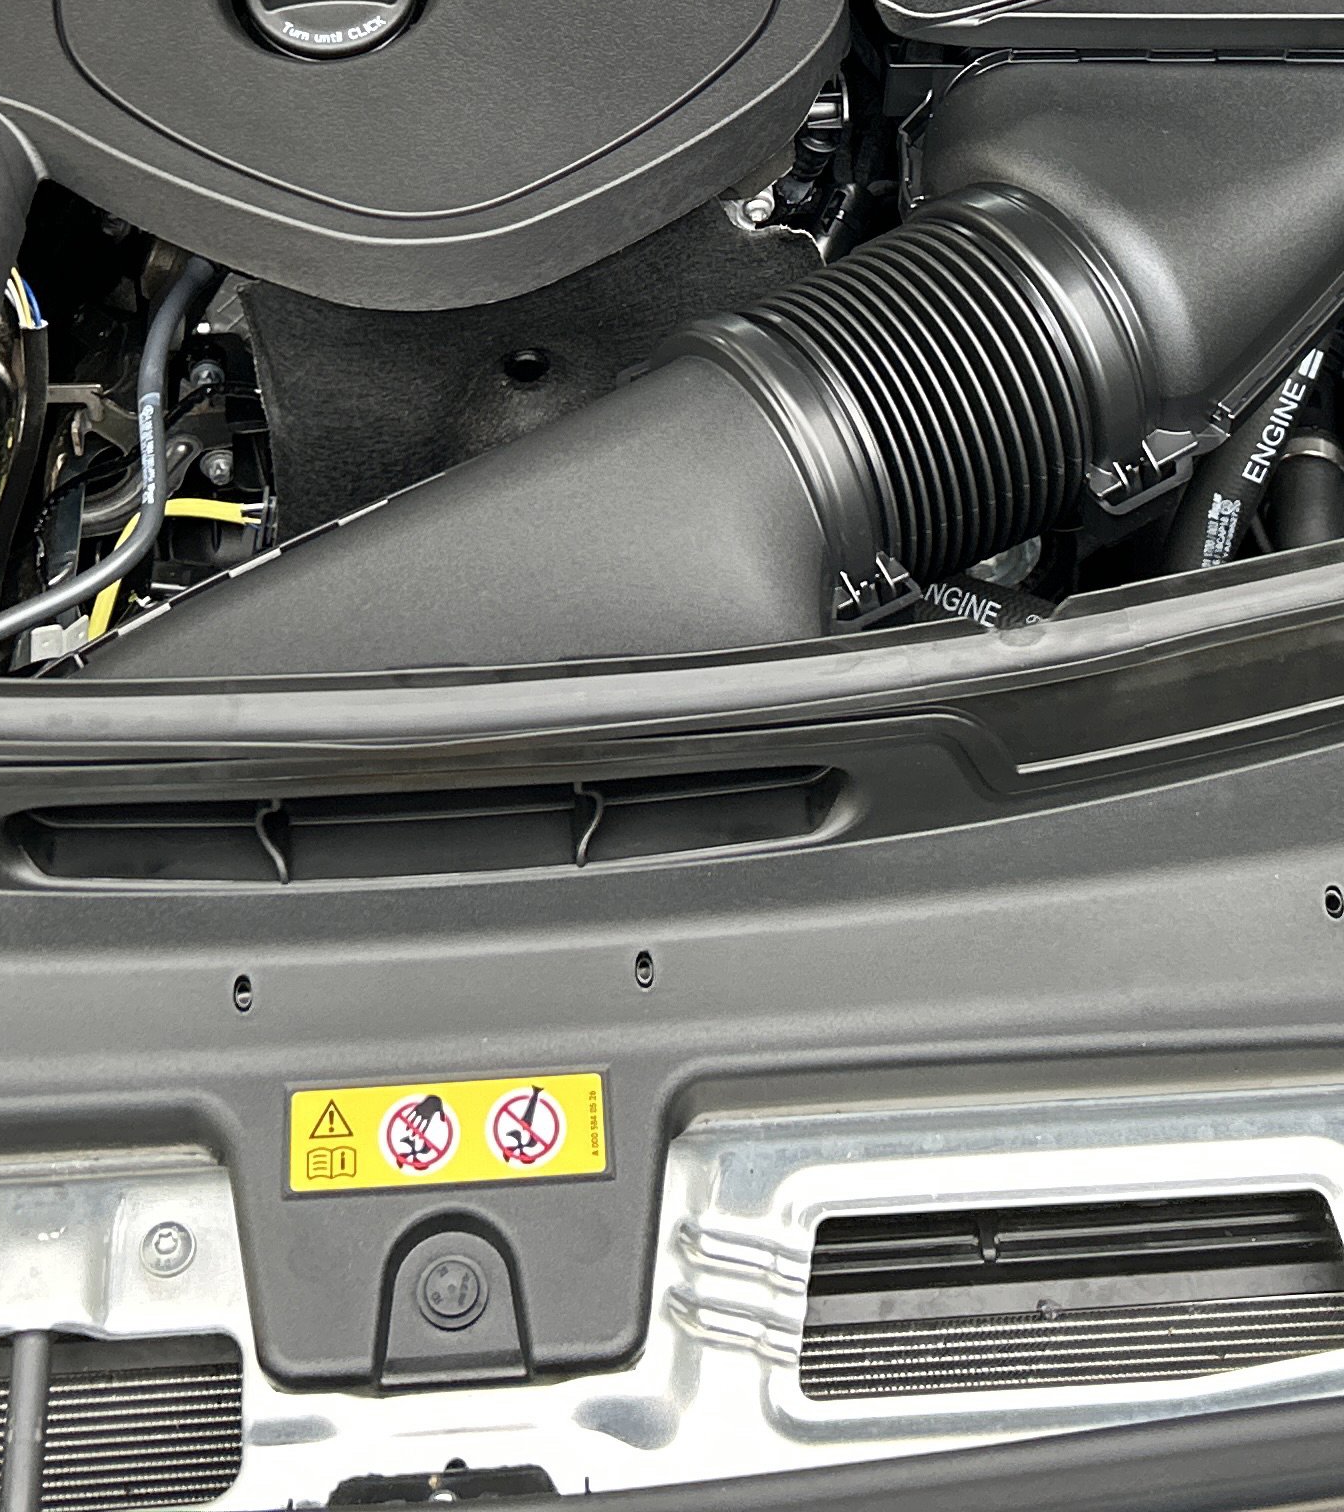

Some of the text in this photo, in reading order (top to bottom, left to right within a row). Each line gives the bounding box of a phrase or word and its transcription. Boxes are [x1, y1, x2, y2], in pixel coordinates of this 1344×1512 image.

[282, 15, 387, 44] Turn until CLICK
[1242, 375, 1307, 484] ENGINE
[923, 583, 1002, 628] NGINE
